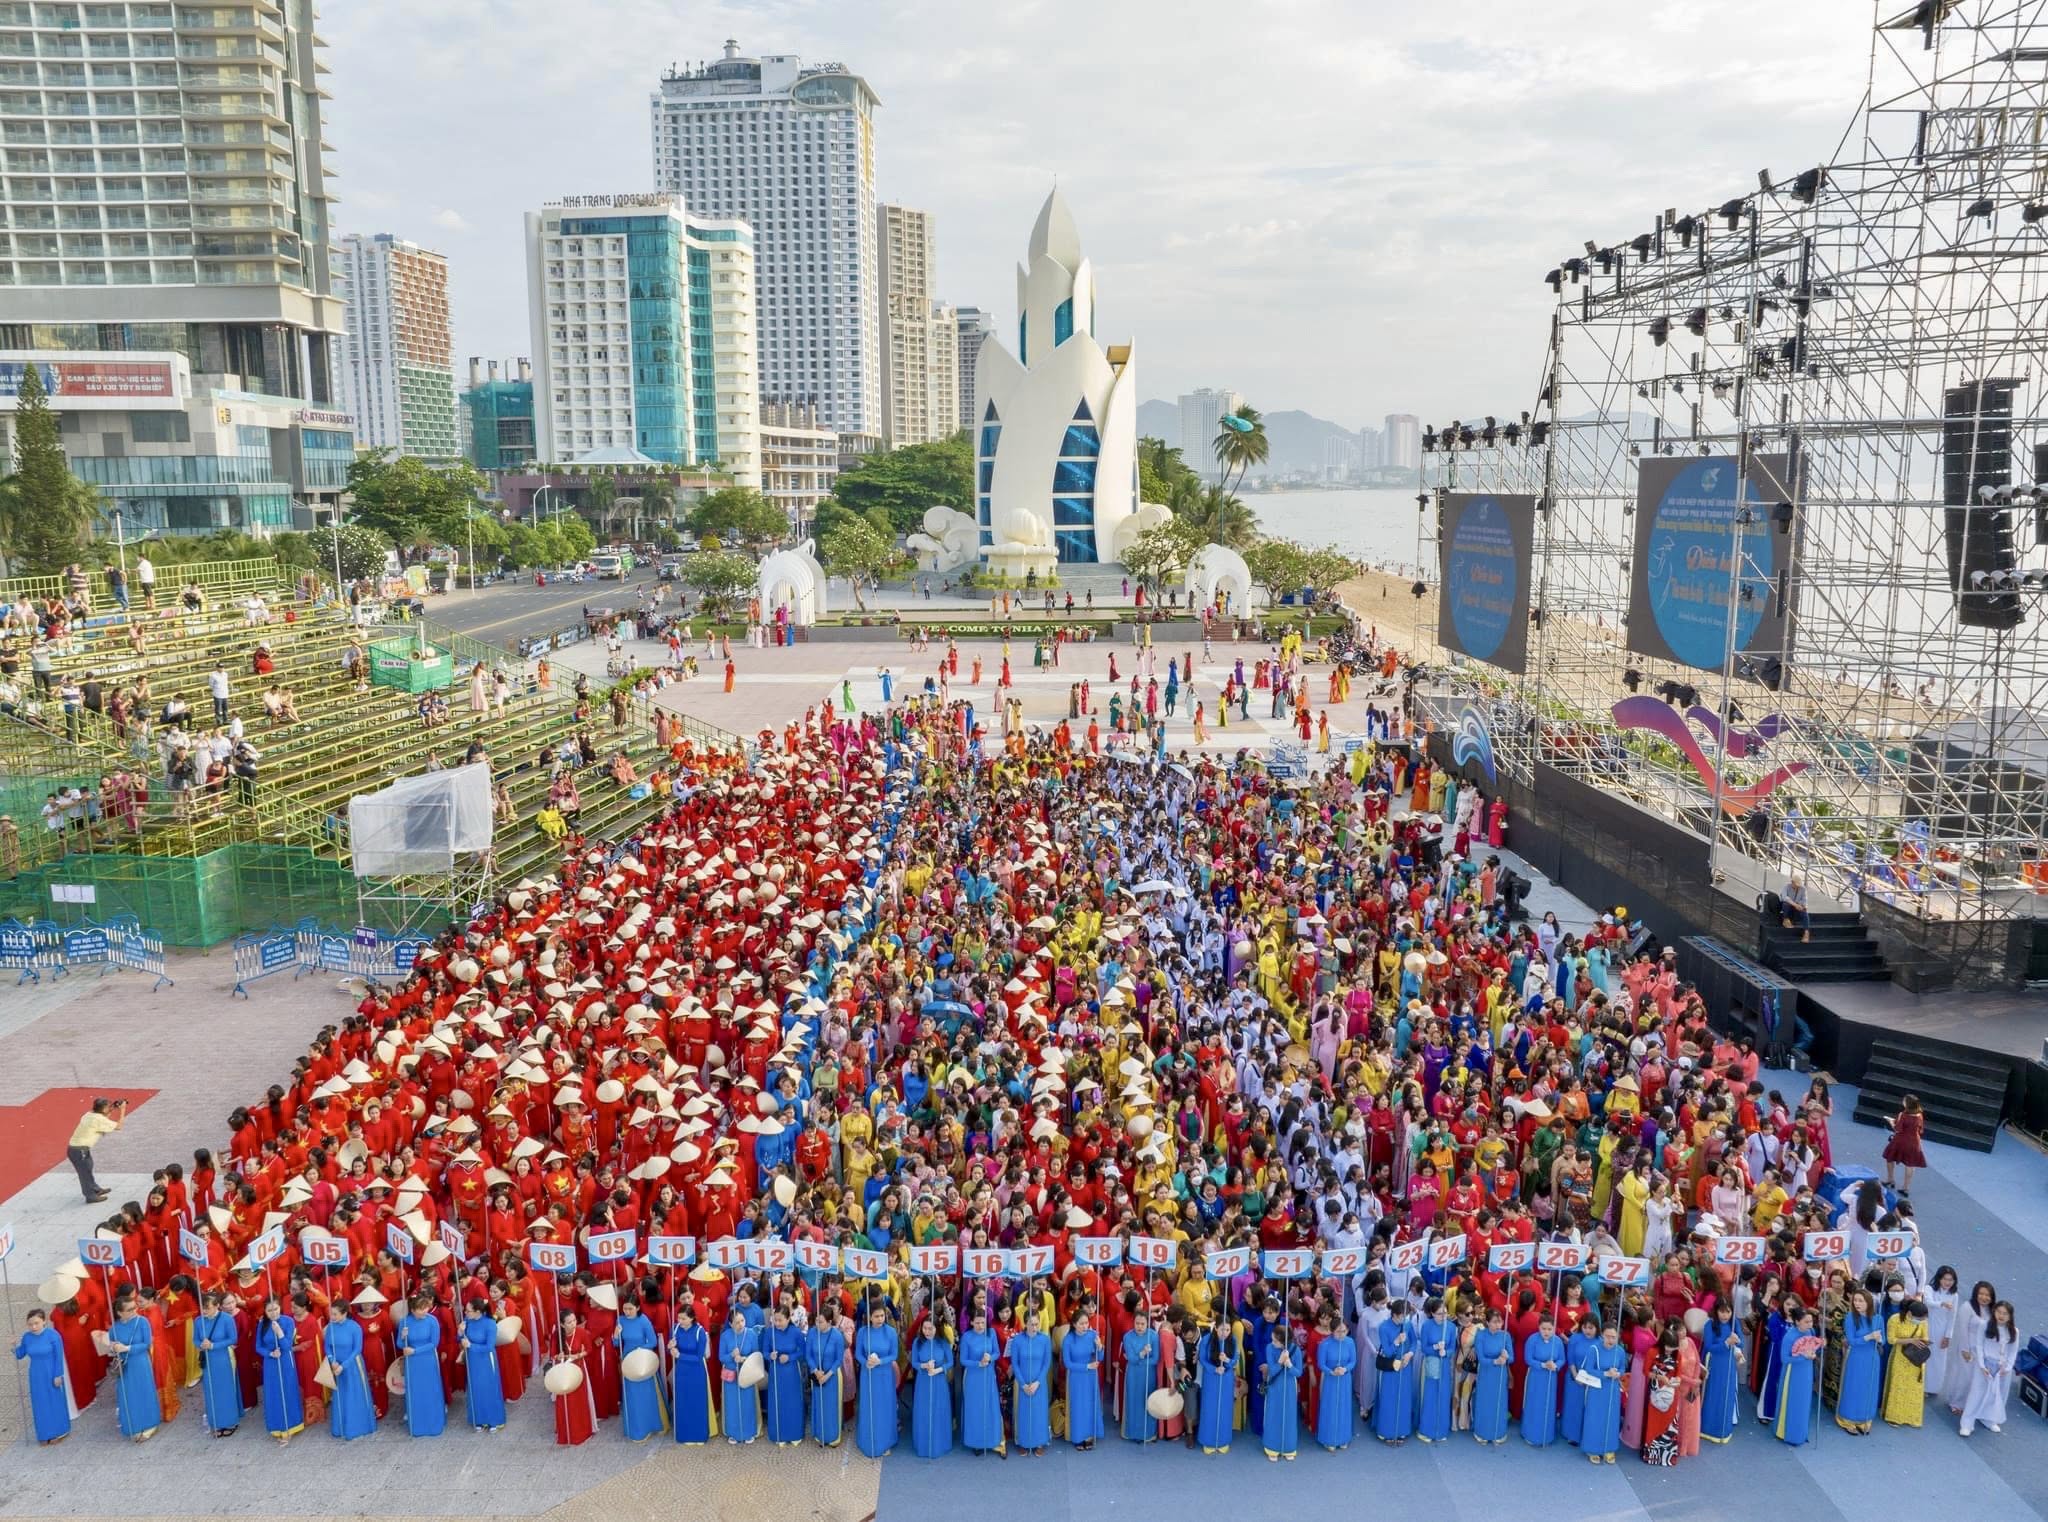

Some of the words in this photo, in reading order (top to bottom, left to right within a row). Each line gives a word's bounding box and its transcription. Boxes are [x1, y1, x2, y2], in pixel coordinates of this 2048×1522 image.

[563, 196, 580, 208] NHA
[583, 195, 611, 208] TRANG
[186, 1238, 202, 1258] 03
[258, 1236, 276, 1261] 04
[392, 1233, 407, 1255] 06
[444, 1230, 459, 1252] 07
[598, 1238, 627, 1257] 09
[658, 1242, 686, 1259] 10
[1725, 1241, 1757, 1260] 28
[1813, 1236, 1844, 1256] 29
[1876, 1238, 1903, 1254] 30
[88, 1244, 114, 1261] 02
[310, 1241, 341, 1261] 05
[540, 1250, 567, 1267] 08
[718, 1244, 746, 1264] 11
[754, 1249, 786, 1268] 12
[802, 1246, 831, 1268] 13
[918, 1251, 949, 1270] 15
[1085, 1243, 1112, 1261] 18
[1137, 1242, 1169, 1264] 19
[1398, 1245, 1423, 1268] 23
[1435, 1242, 1460, 1265] 24
[1500, 1249, 1525, 1267] 25
[1546, 1248, 1580, 1267] 26
[853, 1255, 879, 1274] 14
[971, 1254, 1003, 1273] 16
[1016, 1252, 1048, 1272] 17
[1215, 1255, 1241, 1274] 20
[1275, 1256, 1301, 1273] 21
[1332, 1254, 1358, 1272] 22
[1607, 1262, 1641, 1281] 27
